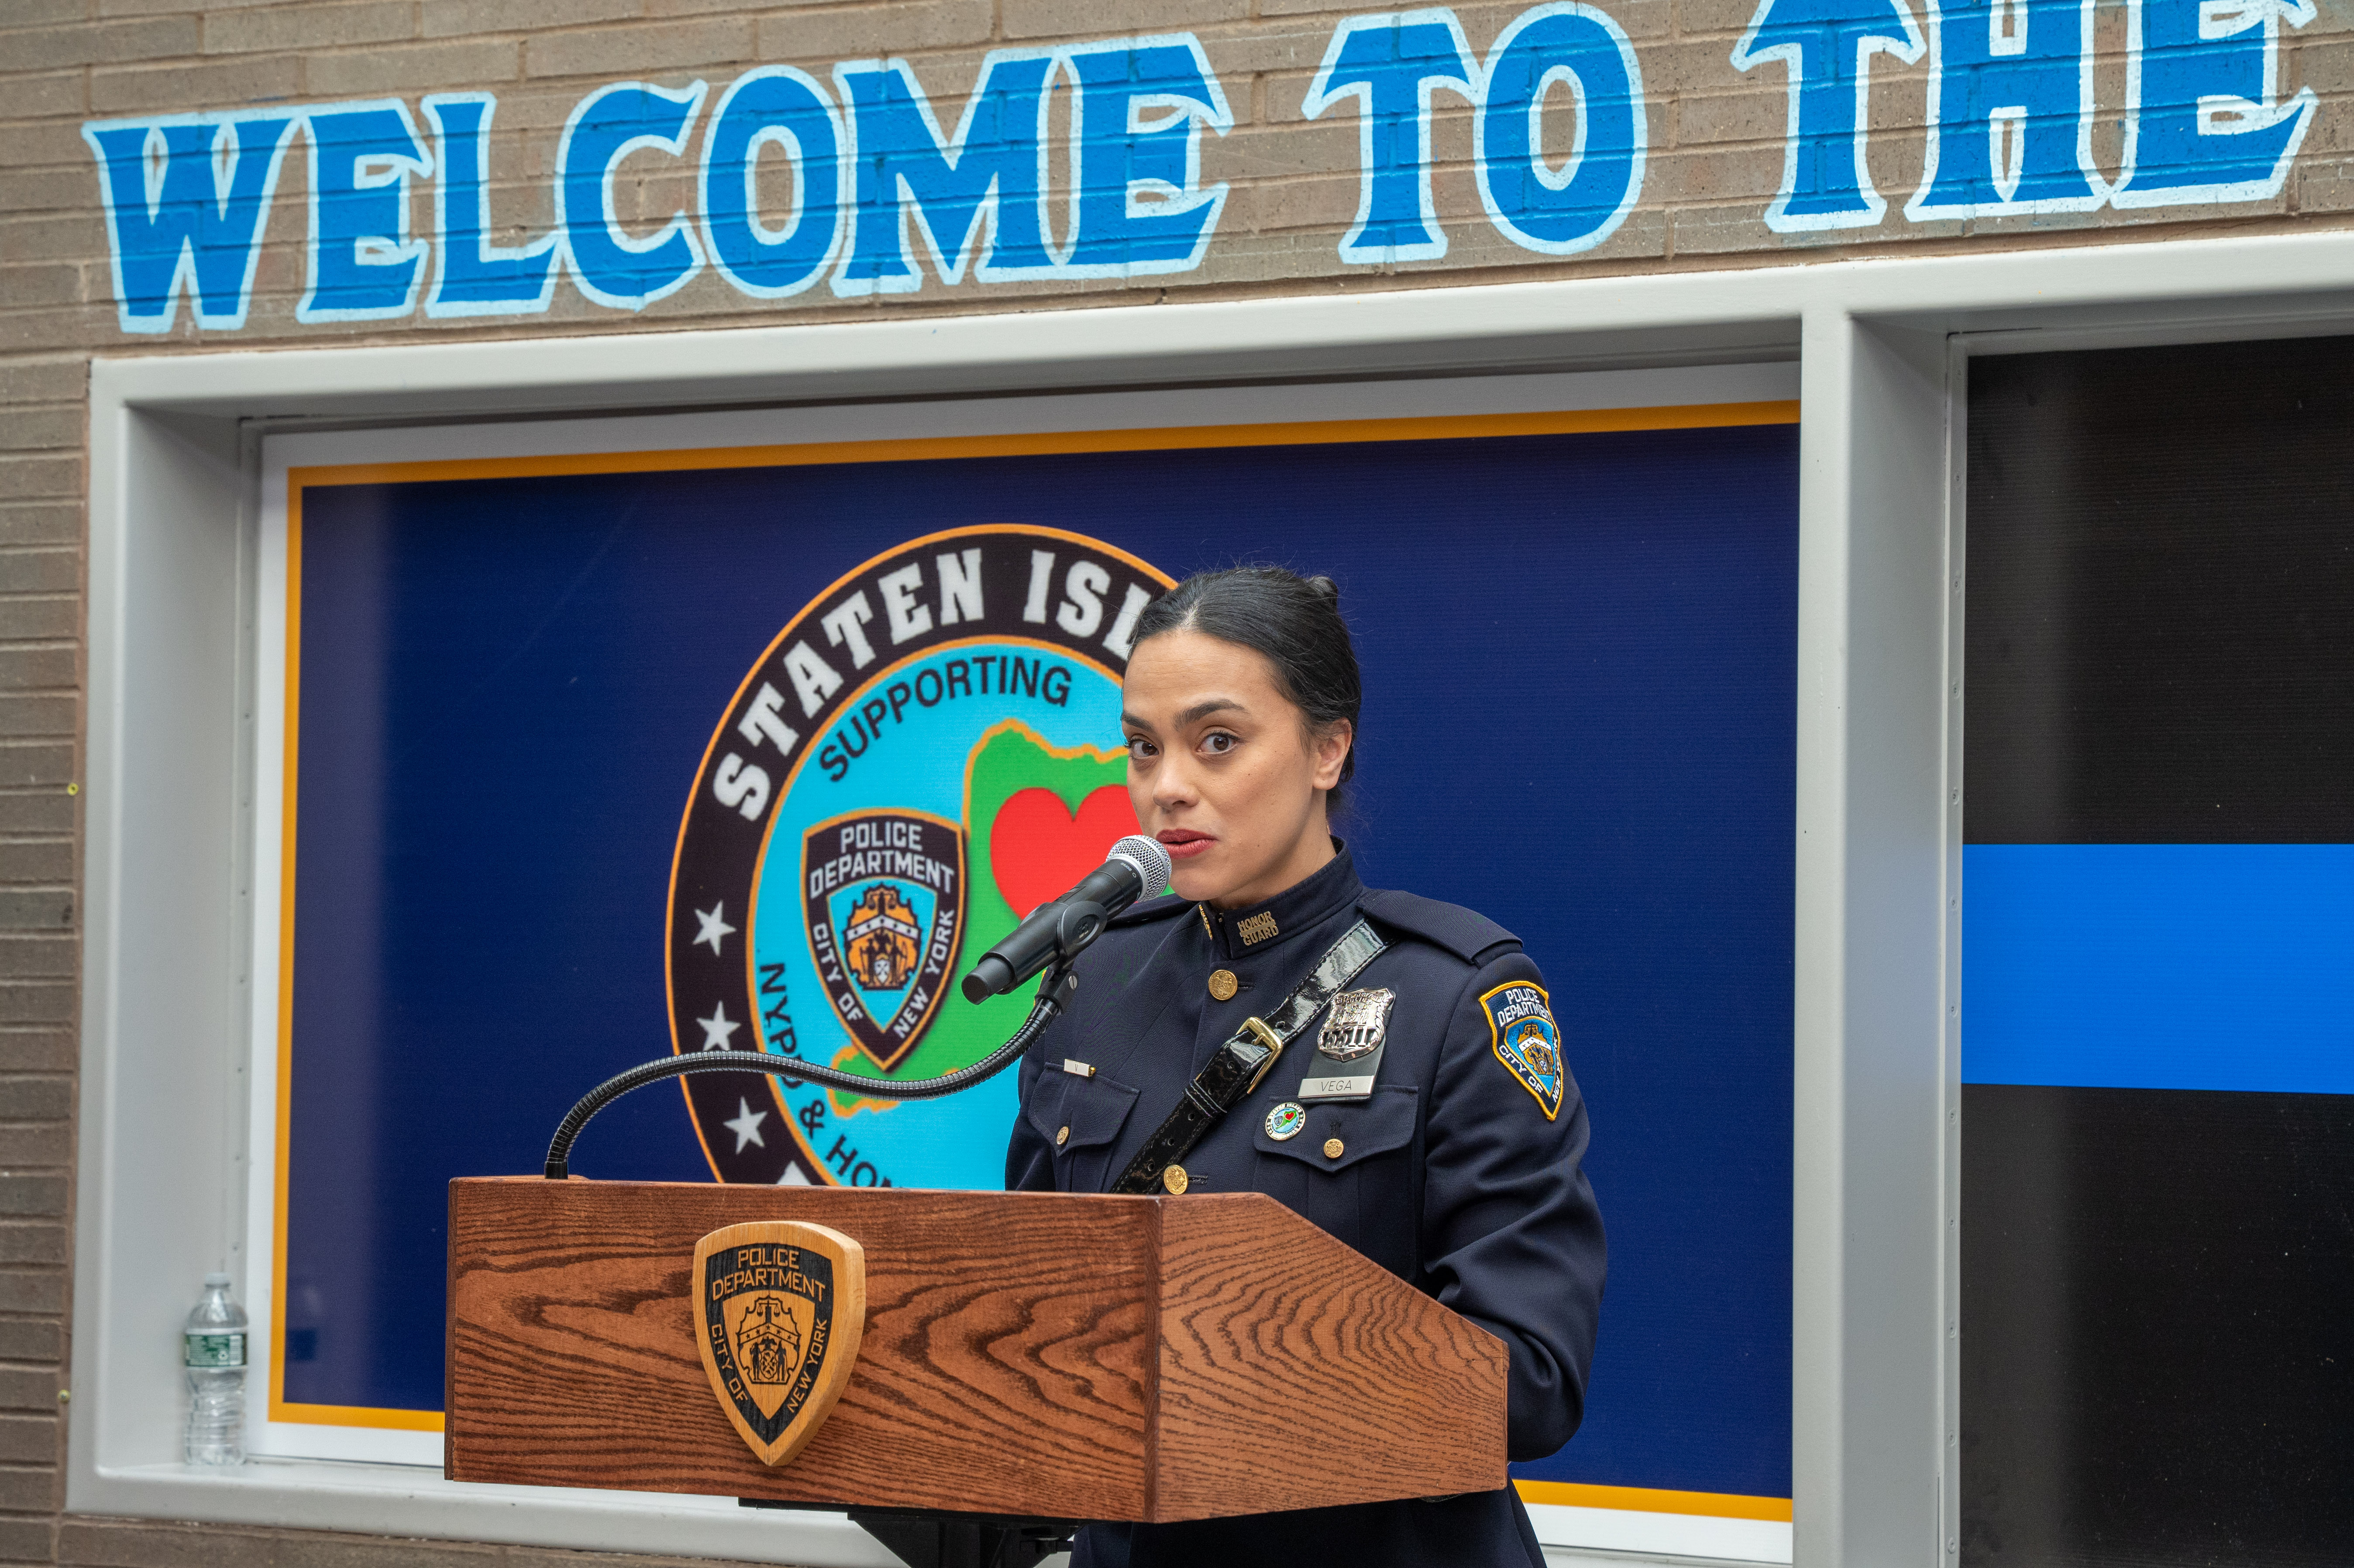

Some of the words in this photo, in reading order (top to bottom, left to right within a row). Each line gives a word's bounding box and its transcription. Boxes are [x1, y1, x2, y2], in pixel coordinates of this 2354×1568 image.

[82, 31, 1235, 333] WELCOME
[1302, 1, 1648, 264] TO
[1729, 0, 2320, 233] THE
[713, 548, 984, 821] STATEN
[820, 655, 1072, 782] SUPPORTING
[840, 822, 922, 853] POLICE
[810, 850, 955, 899] DEPARTMENT
[1120, 862, 1132, 871] SM58
[1237, 911, 1274, 932] HONOR
[1243, 925, 1279, 946] GUARD
[813, 923, 842, 982] CITY
[838, 992, 864, 1021] OF
[893, 987, 929, 1039] NEW
[925, 910, 955, 975] YORK
[1505, 988, 1540, 1004] POLICE
[1497, 1001, 1553, 1027] DEPARTMENT
[1326, 1026, 1368, 1048] 5511
[1321, 1080, 1352, 1091] VEGA
[1499, 1045, 1527, 1073] CITY
[1528, 1076, 1543, 1093] OF
[1552, 1076, 1561, 1103] NEW
[800, 1099, 826, 1139] &
[738, 1248, 799, 1269] POLICE
[712, 1268, 826, 1302] DEPARTMENT
[712, 1324, 733, 1371] CITY
[729, 1378, 750, 1403] OF
[787, 1371, 813, 1413] NEW
[807, 1319, 827, 1365] YORK
